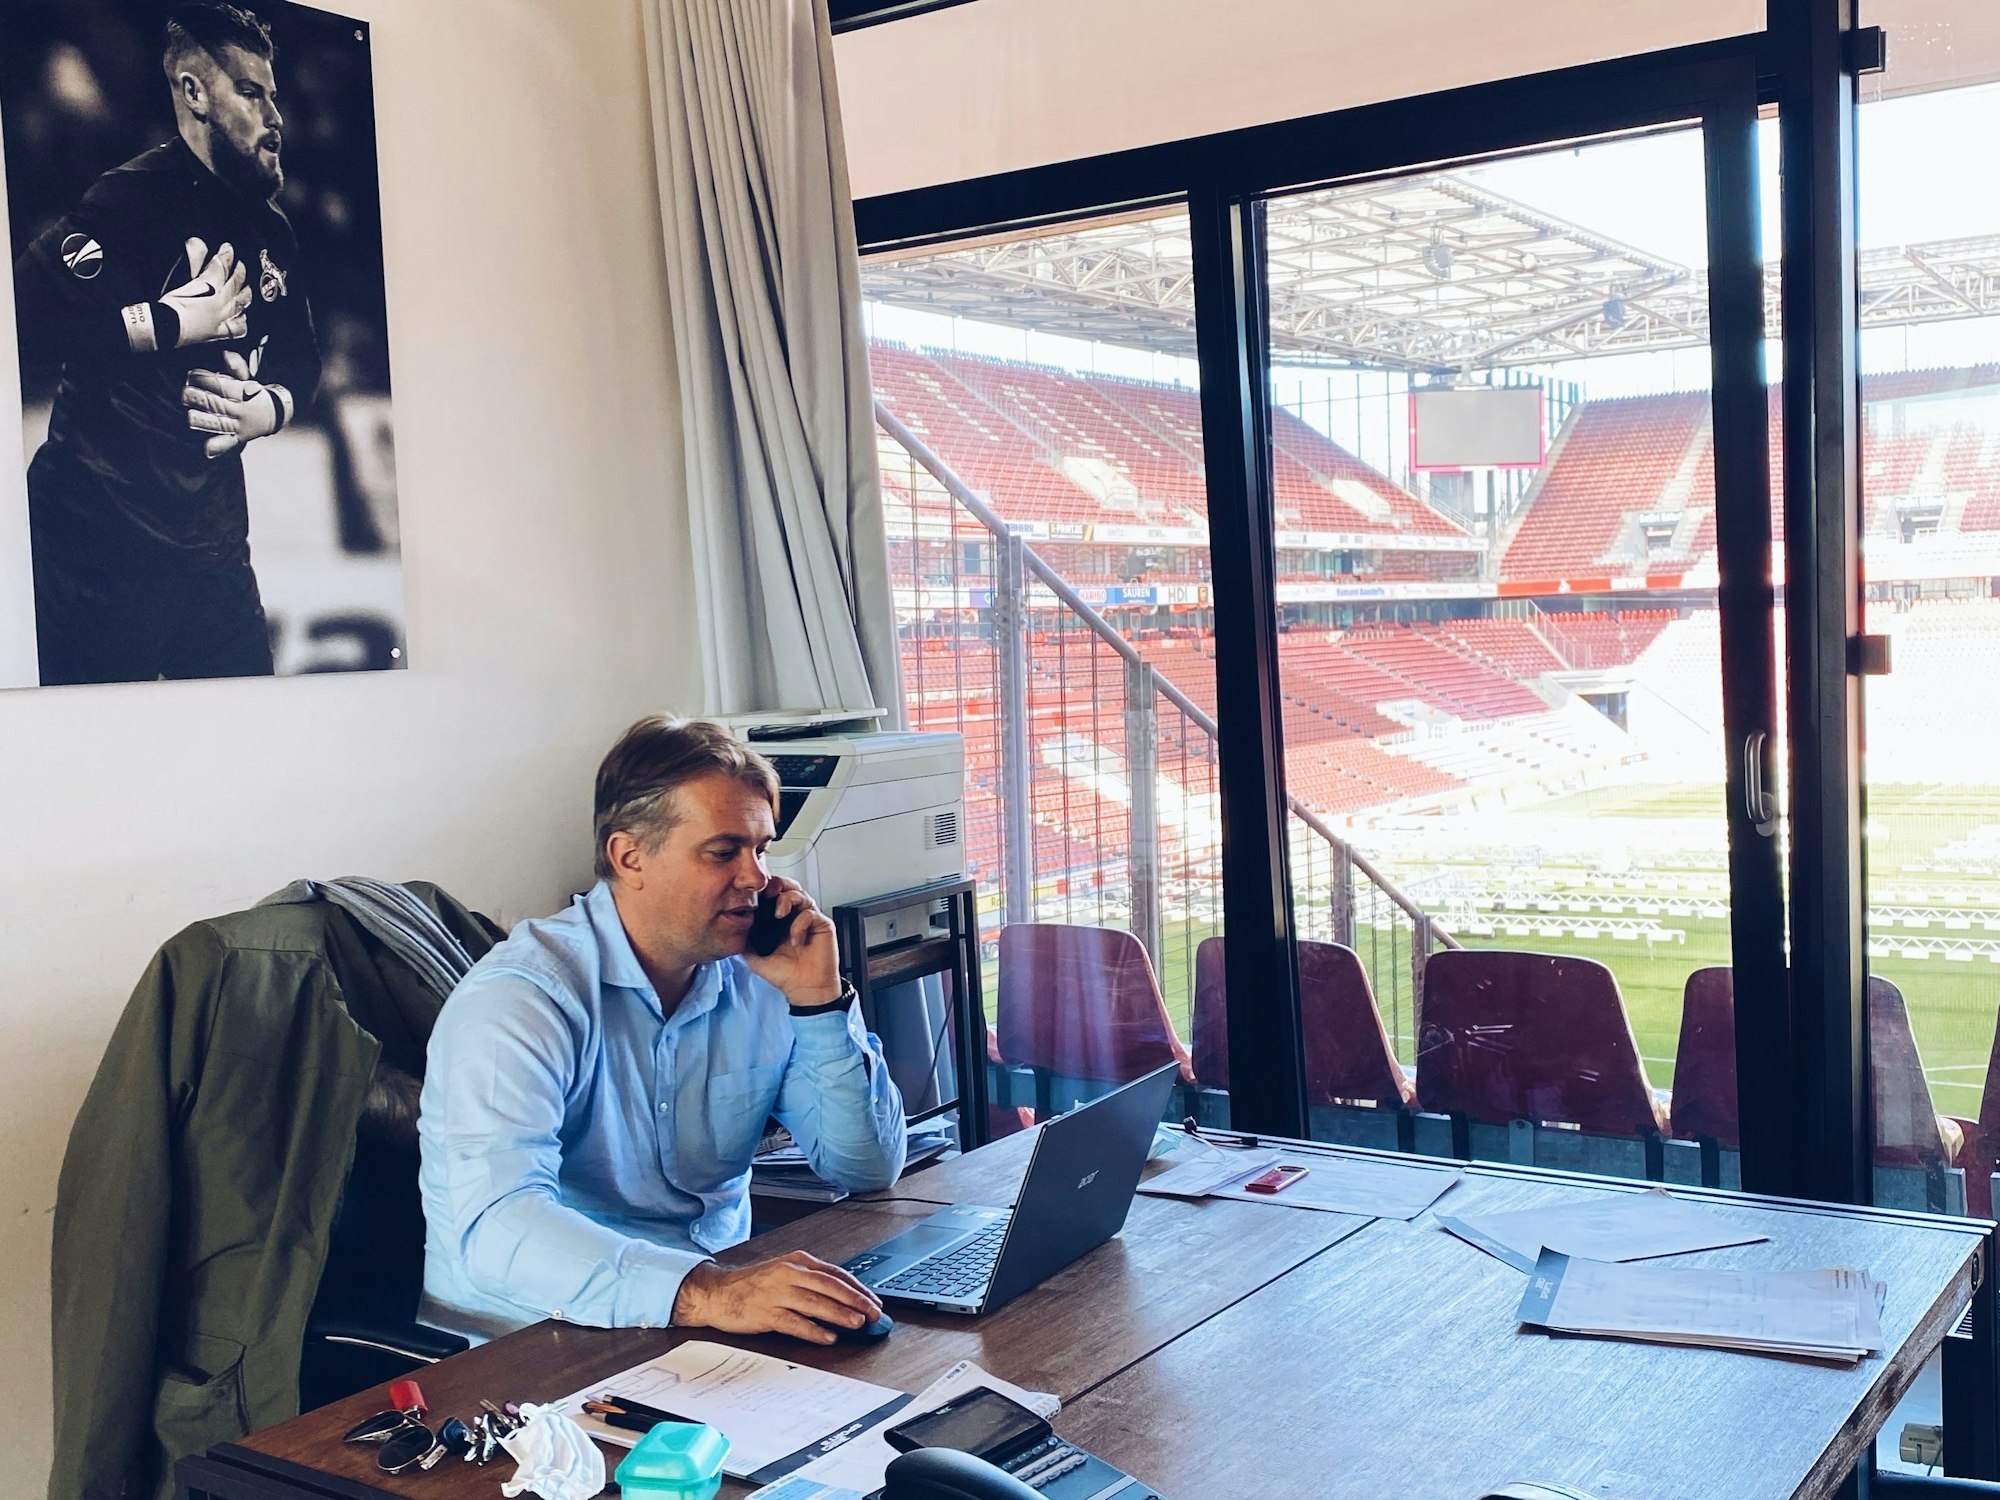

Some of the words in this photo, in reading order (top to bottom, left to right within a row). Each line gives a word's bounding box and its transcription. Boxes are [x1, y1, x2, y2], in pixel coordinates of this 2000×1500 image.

[1080, 589, 1107, 603] HARIBO
[1123, 587, 1151, 599] SAUREN
[1077, 1170, 1099, 1189] acer
